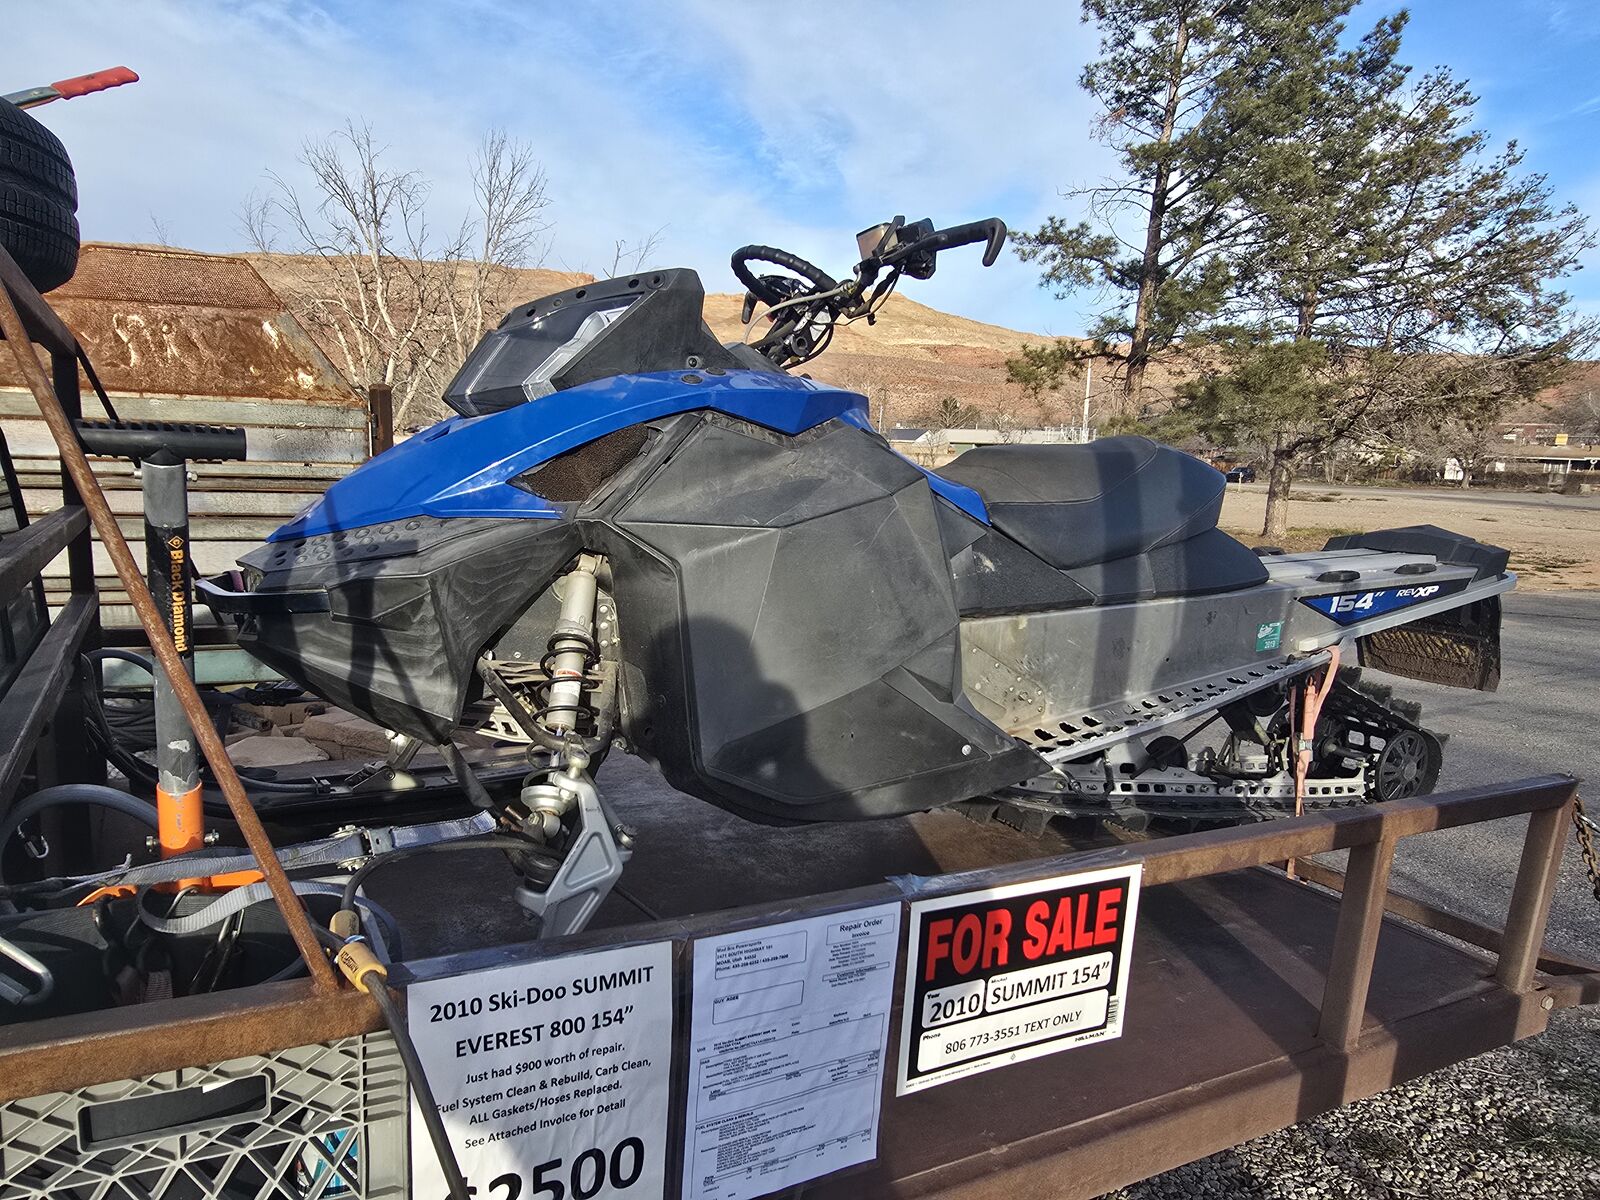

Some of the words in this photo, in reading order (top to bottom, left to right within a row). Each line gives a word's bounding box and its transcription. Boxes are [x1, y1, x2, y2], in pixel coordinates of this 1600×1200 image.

[170, 550, 185, 592] Black
[172, 592, 188, 652] Diamond
[840, 922, 862, 932] Repair
[863, 918, 884, 928] Order
[852, 930, 870, 938] Invoice
[925, 908, 1012, 982] FOR
[1022, 887, 1122, 961] SALE
[430, 997, 482, 1023] 2010
[488, 985, 567, 1012] Ski-Doo
[572, 966, 654, 996] SUMMIT
[929, 993, 980, 1023] 2010
[991, 972, 1068, 1005] SUMMIT
[455, 1024, 545, 1058] EVEREST
[550, 1016, 586, 1038] 800
[945, 1038, 966, 1054] 806
[969, 1025, 1020, 1048] 773-3551
[1024, 1018, 1051, 1034] TEXT
[1052, 1010, 1082, 1026] ONLY
[462, 1091, 504, 1110] System
[506, 1084, 536, 1098] Clean
[538, 1080, 548, 1090] &
[550, 1070, 593, 1088] Rebuild,
[595, 1064, 619, 1078] Carb
[621, 1058, 652, 1072] Clean,
[466, 1072, 488, 1084] Just
[491, 1064, 512, 1078] had
[515, 1058, 542, 1076] $900
[544, 1052, 576, 1068] worth
[579, 1048, 590, 1059] of
[592, 1042, 626, 1058] repair.
[464, 1138, 485, 1150] See
[487, 1123, 537, 1144] Attached
[539, 1113, 577, 1129] Invoice
[579, 1108, 595, 1119] for
[596, 1098, 626, 1115] Detail
[469, 1114, 490, 1126] ALL
[492, 1093, 571, 1122] Gaskets/Hoses
[573, 1080, 623, 1102] Replaced.
